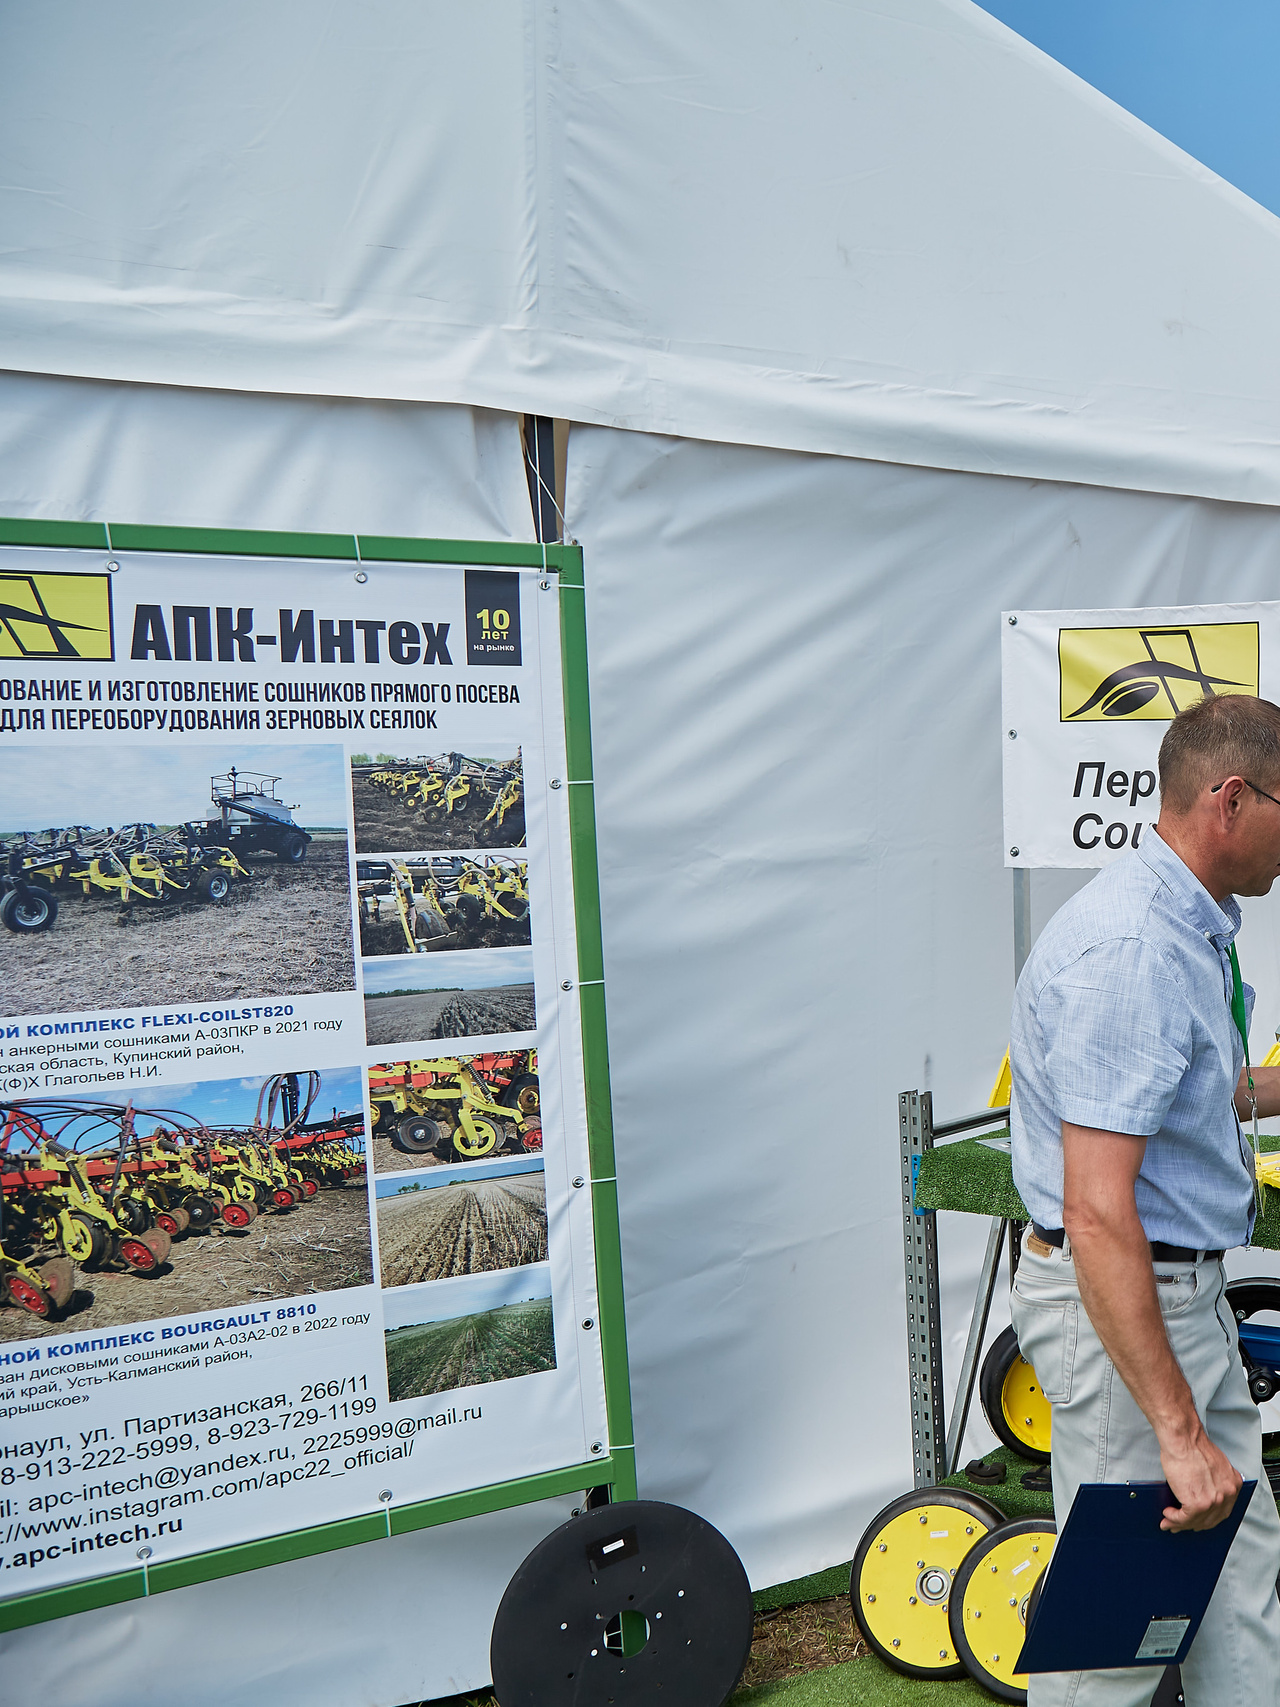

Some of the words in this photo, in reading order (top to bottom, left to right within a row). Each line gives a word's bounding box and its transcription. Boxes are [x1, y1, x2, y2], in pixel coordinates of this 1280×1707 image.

[130, 603, 453, 666] АПК-Интех
[476, 608, 510, 630] 10
[480, 630, 509, 640] лет
[486, 644, 515, 652] рынке
[88, 680, 102, 701] И
[108, 680, 259, 702] ИЗГОТОВЛЕНИЕ
[264, 682, 366, 702] СОШНИКОВ
[371, 683, 451, 704] ПРЯМОГО
[456, 684, 520, 704] ПОСЕВА
[0, 708, 45, 732] ДЛЯ
[52, 708, 260, 732] ПЕРЕОБОРУДОВАНИЯ
[266, 710, 366, 730] ЗЕРНОВЫХ
[370, 710, 438, 729] СЕЯЛОК
[9, 1040, 98, 1057] анкерными
[104, 1033, 190, 1049] сошниками
[264, 1027, 272, 1035] в
[275, 1020, 308, 1034] 2021
[314, 1019, 343, 1032] году
[27, 1017, 135, 1037] КОМПЛЕКС
[142, 1004, 294, 1028] FLEXI-COILST820
[40, 1056, 108, 1071] область,
[113, 1047, 192, 1066] Купинский
[196, 1044, 244, 1059] район,
[0, 1076, 40, 1092] (Ф)Х
[45, 1070, 125, 1087] Глагольев
[130, 1065, 162, 1079] Н.И.
[30, 1356, 119, 1381] дисковыми
[124, 1340, 209, 1364] сошниками
[292, 1326, 300, 1334] в
[304, 1316, 338, 1332] 2022
[342, 1312, 371, 1326] году
[48, 1330, 155, 1358] КОМПЛЕКС
[161, 1311, 270, 1340] BOURGAULT
[276, 1304, 317, 1320] 8810
[20, 1380, 62, 1398] край,
[67, 1356, 200, 1389] Усть-Калманский
[204, 1350, 253, 1368] район,
[0, 1436, 71, 1459] наул,
[80, 1428, 115, 1450] ул.
[124, 1393, 294, 1437] Партизанская,
[300, 1374, 368, 1403] 266/11
[0, 1434, 199, 1486] 8-913-222-5999,
[208, 1397, 377, 1446] 8-923-729-1199
[28, 1446, 296, 1512] apc-intech@yandex.ru,
[303, 1406, 483, 1455] 2225999@mail.ru
[0, 1518, 183, 1570] .apc-intech.ru
